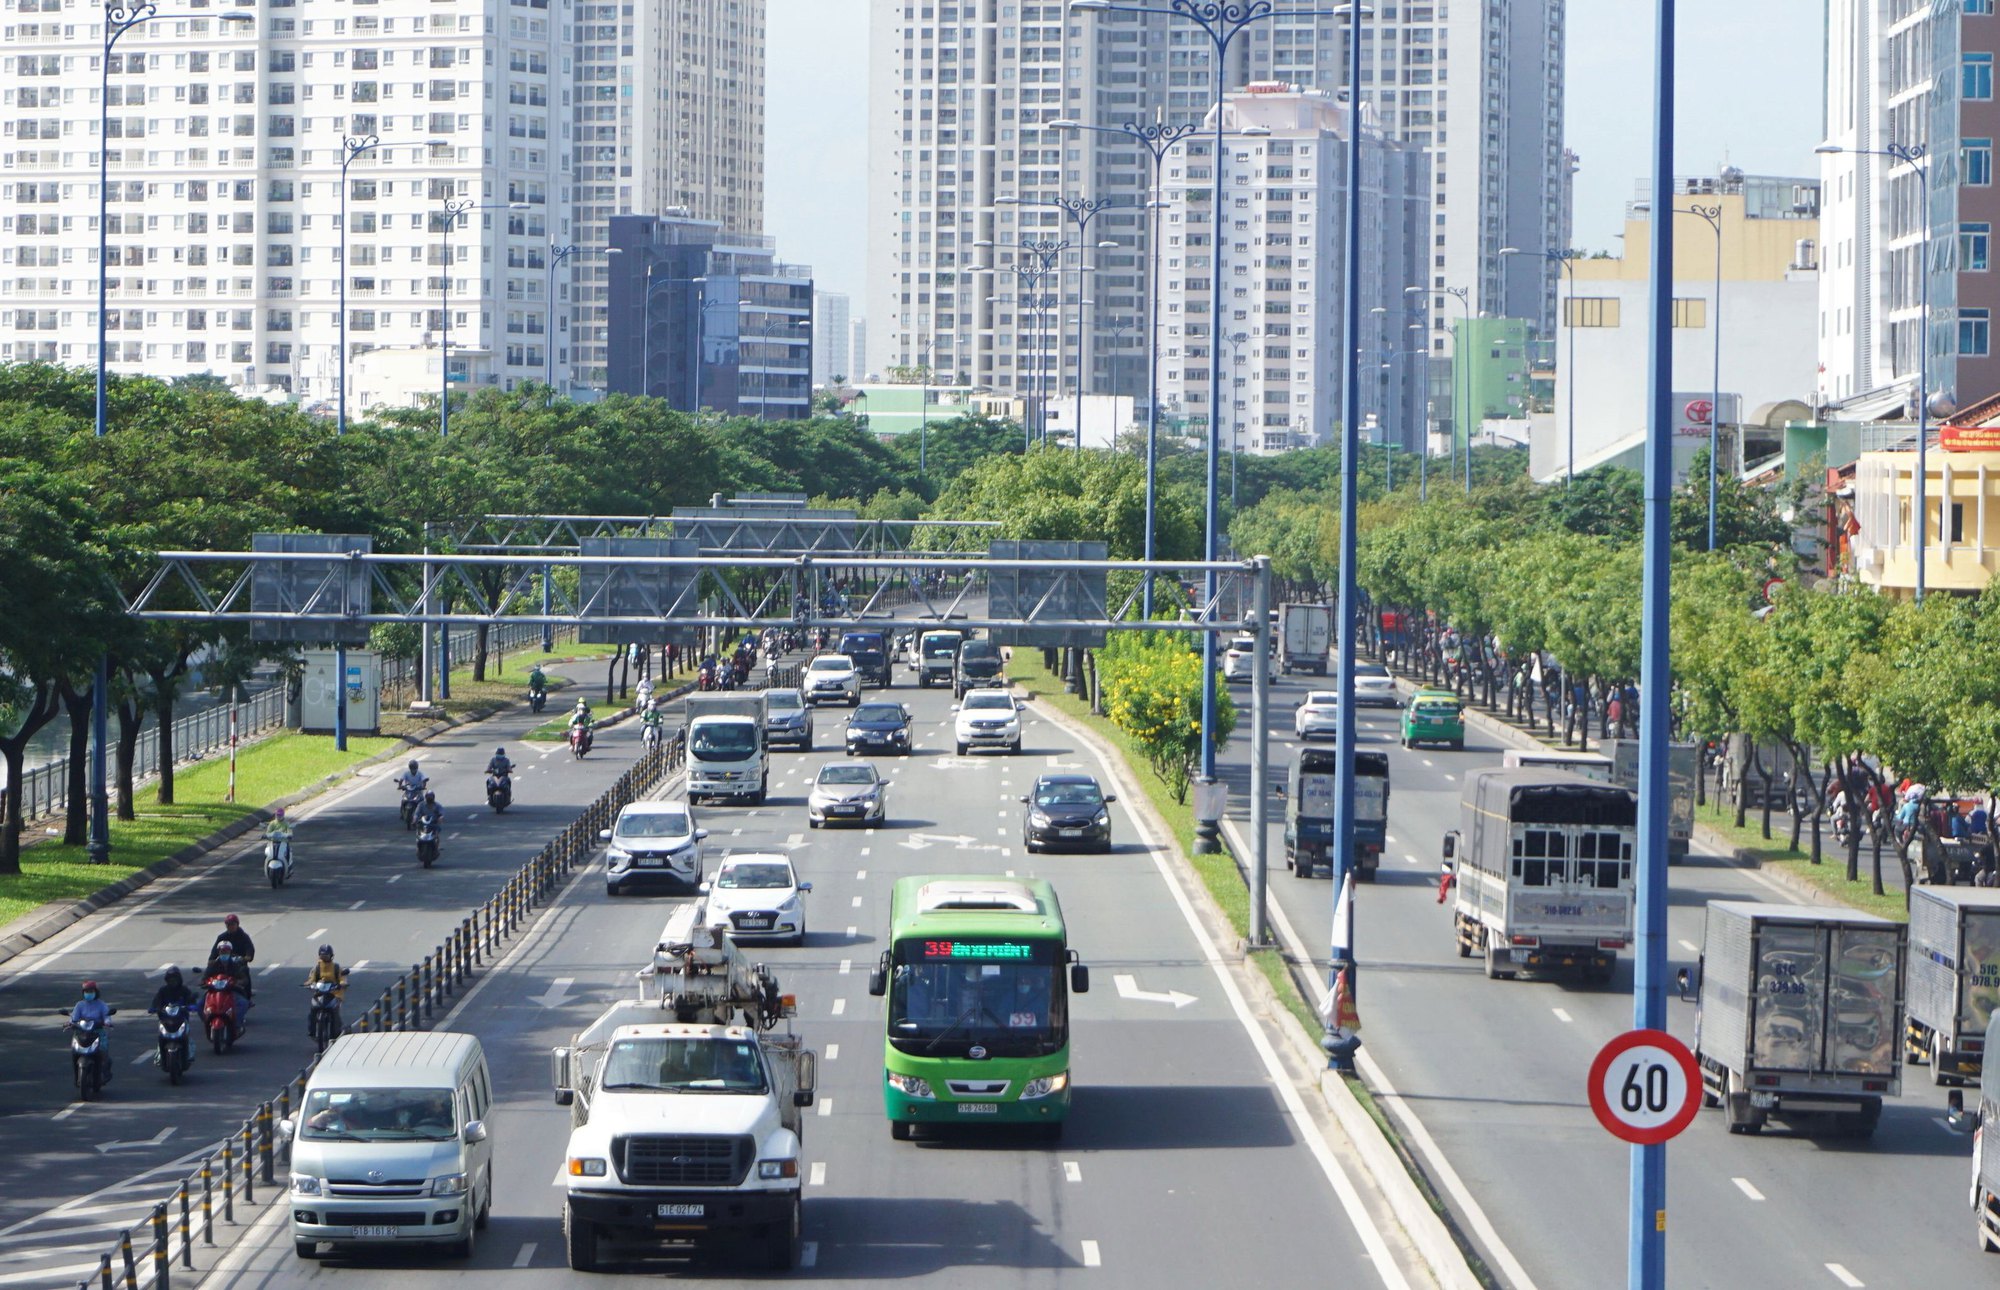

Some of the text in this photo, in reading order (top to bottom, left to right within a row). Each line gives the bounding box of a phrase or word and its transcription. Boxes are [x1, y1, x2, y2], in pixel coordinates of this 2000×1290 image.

[925, 941, 951, 957] 39
[1011, 1012, 1035, 1026] 39
[1621, 1063, 1667, 1112] 60
